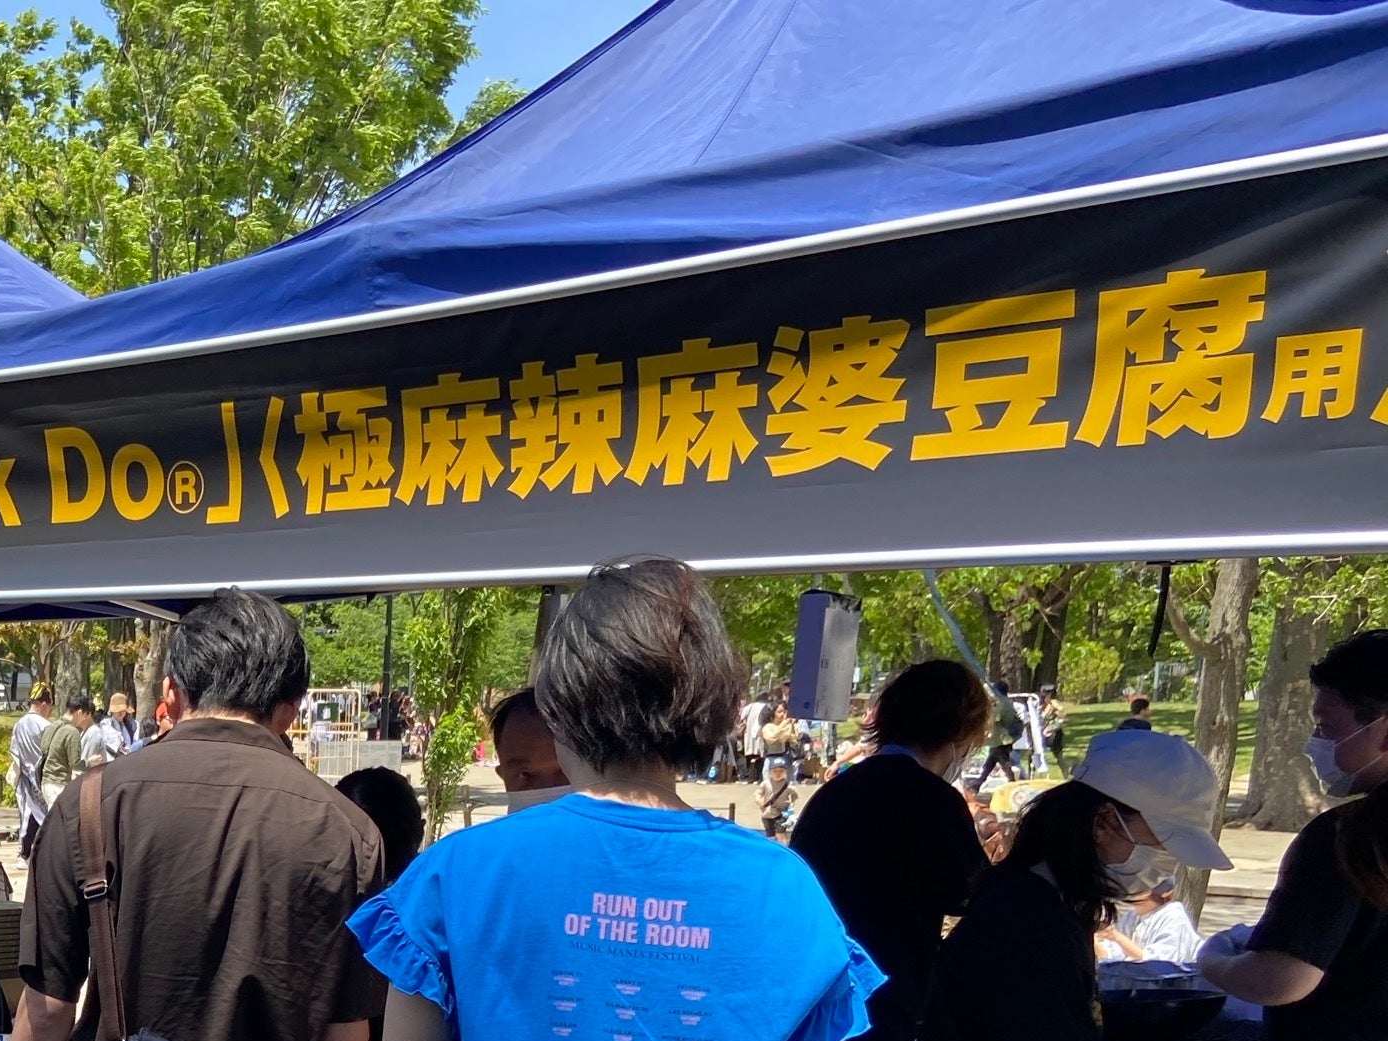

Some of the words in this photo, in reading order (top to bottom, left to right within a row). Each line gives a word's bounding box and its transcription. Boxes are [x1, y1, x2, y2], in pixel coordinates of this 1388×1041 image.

[592, 892, 637, 919] RUN
[643, 898, 687, 922] OUT
[564, 913, 591, 936] OF
[597, 918, 639, 944] THE
[644, 924, 710, 950] ROOM
[569, 940, 609, 953] MUSIC
[648, 950, 701, 963] FESTIVAL
